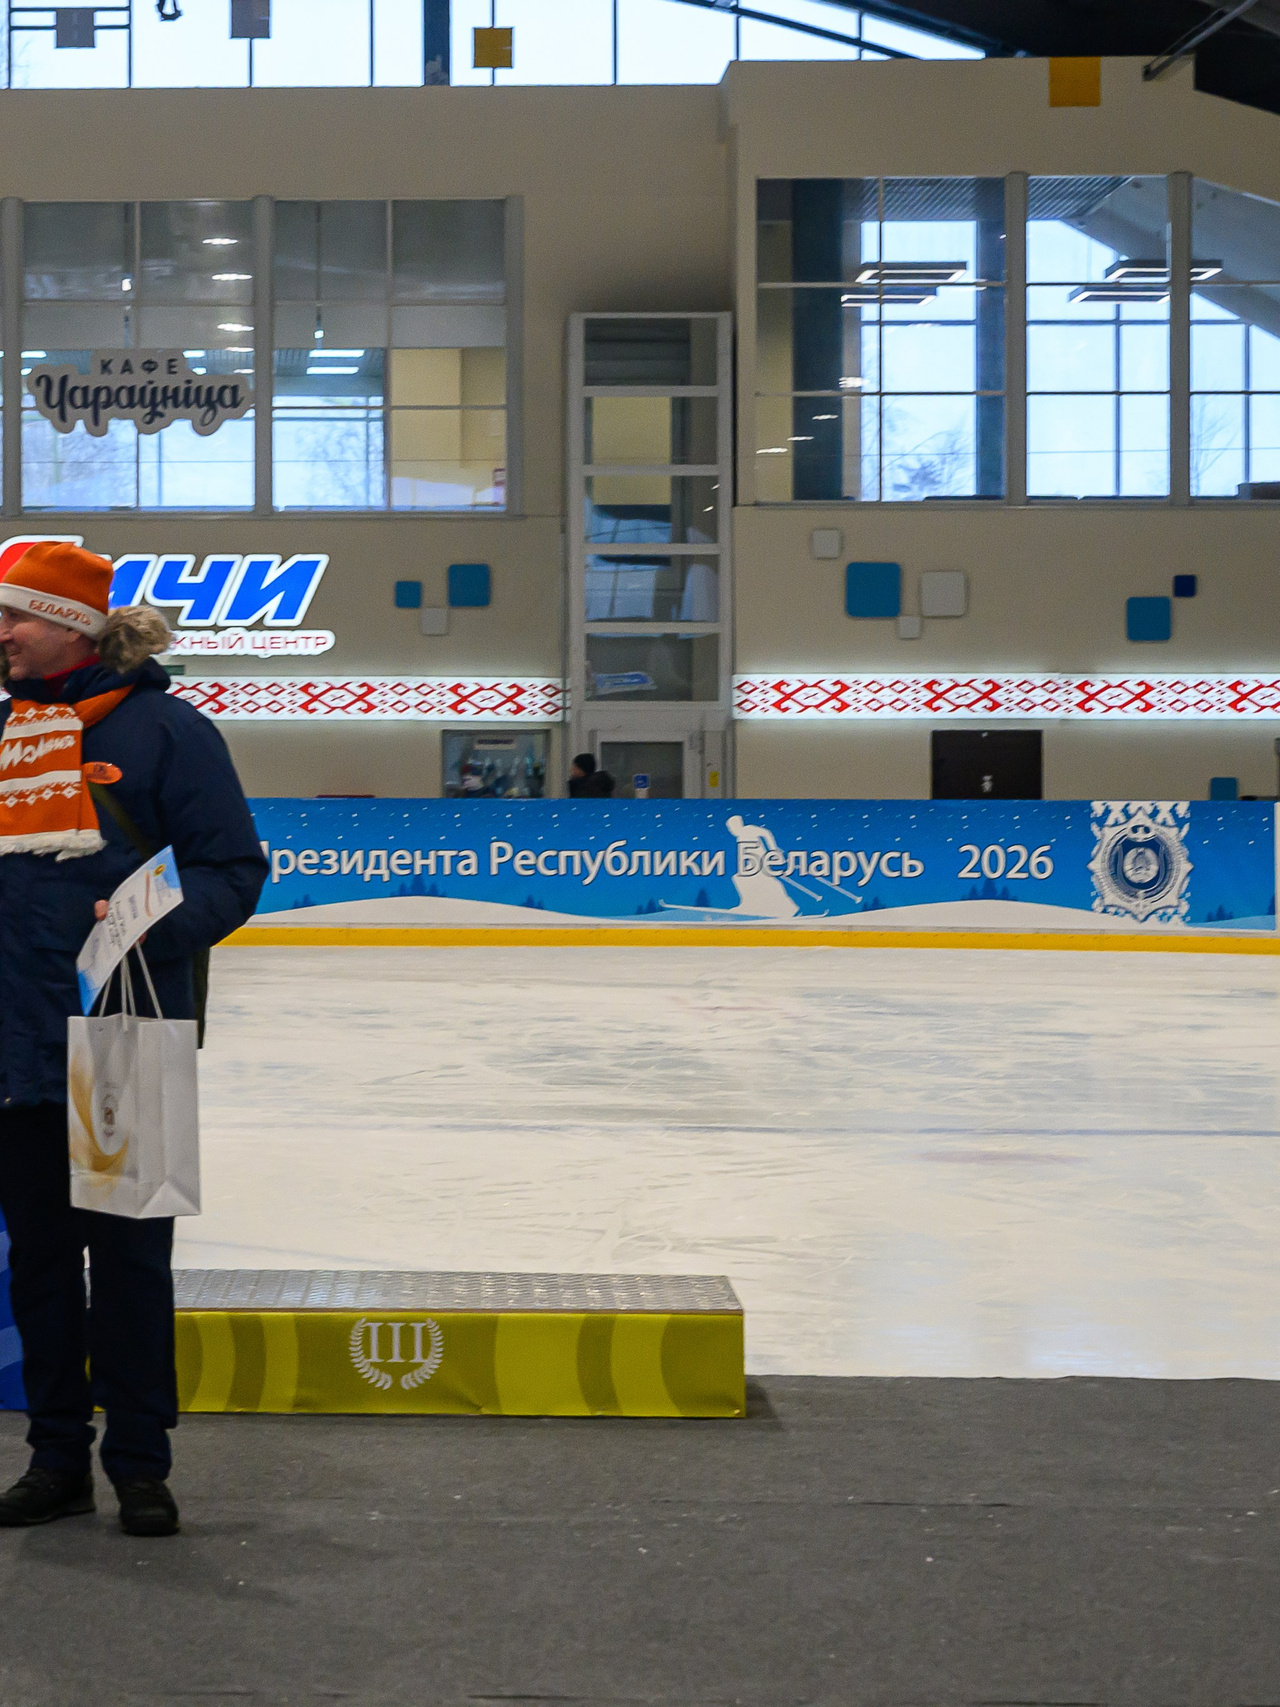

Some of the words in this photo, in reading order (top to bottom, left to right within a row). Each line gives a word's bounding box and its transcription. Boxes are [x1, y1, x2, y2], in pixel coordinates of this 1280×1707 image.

[99, 357, 179, 376] КАФЕ
[252, 635, 328, 655] ЦЕНТР
[489, 840, 726, 885] Республики
[737, 840, 925, 887] Беларусь
[956, 844, 1055, 881] 2026
[363, 1321, 428, 1363] III
